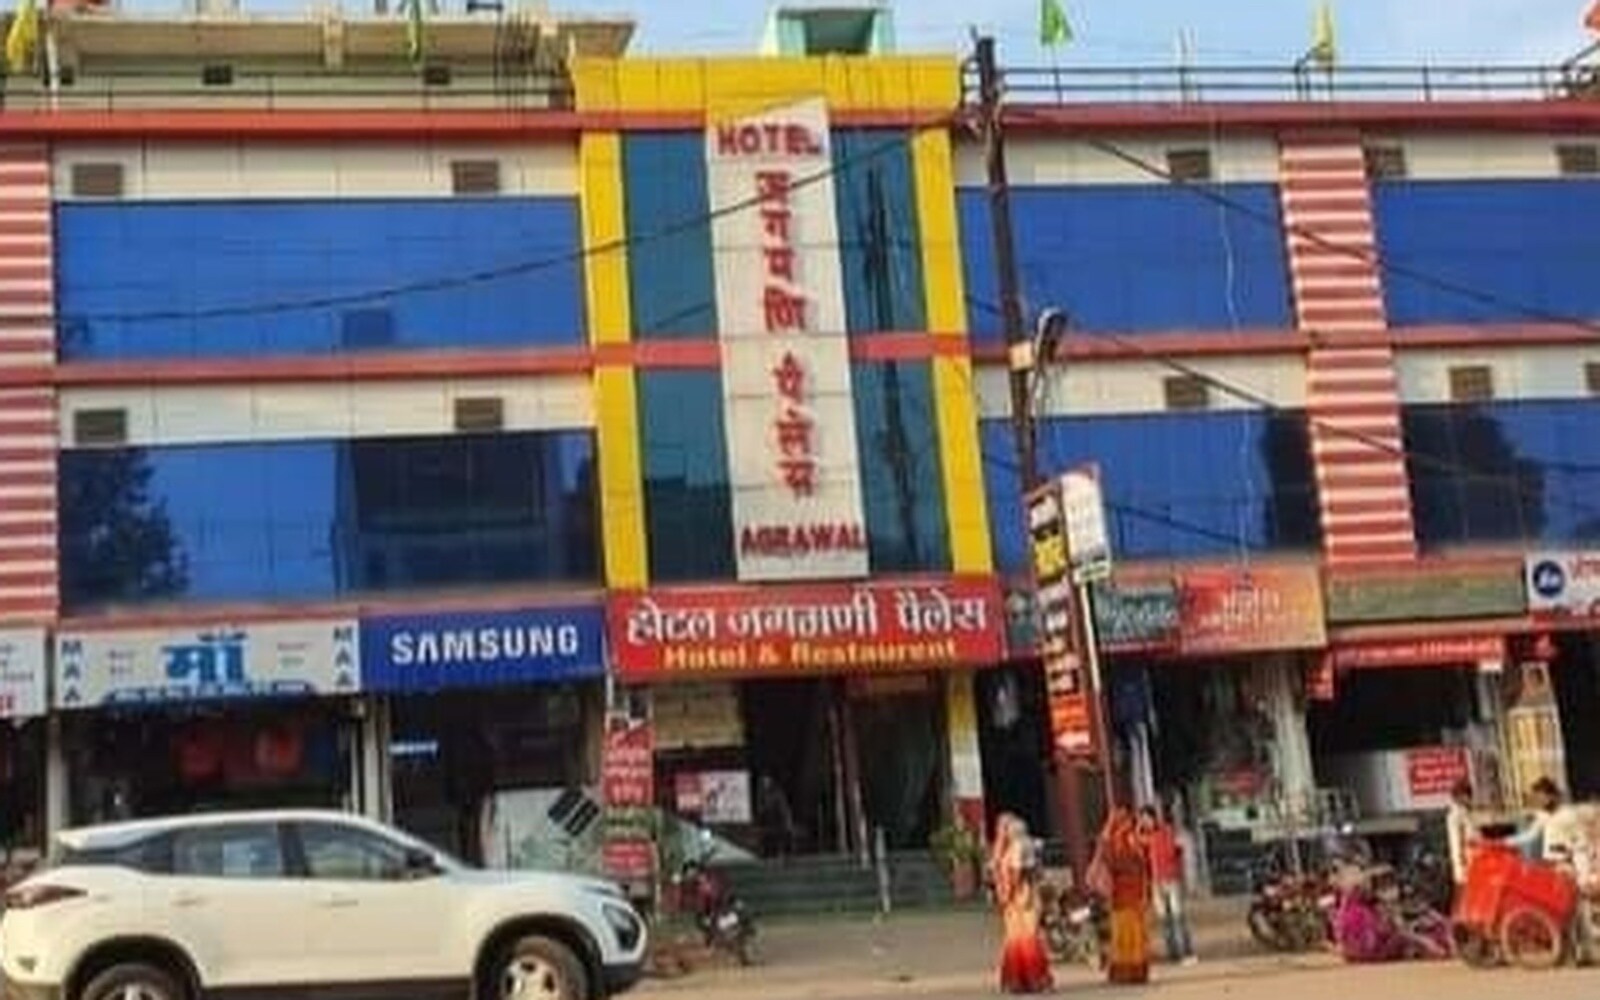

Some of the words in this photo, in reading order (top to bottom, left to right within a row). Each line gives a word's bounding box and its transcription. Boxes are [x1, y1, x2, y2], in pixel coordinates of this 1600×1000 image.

[717, 123, 821, 156] HOTEL
[740, 522, 866, 557] AGRAWAL
[626, 597, 717, 646] होटल
[391, 624, 579, 666] SAMSUNG
[663, 644, 748, 672] Hotel
[758, 642, 781, 665] &
